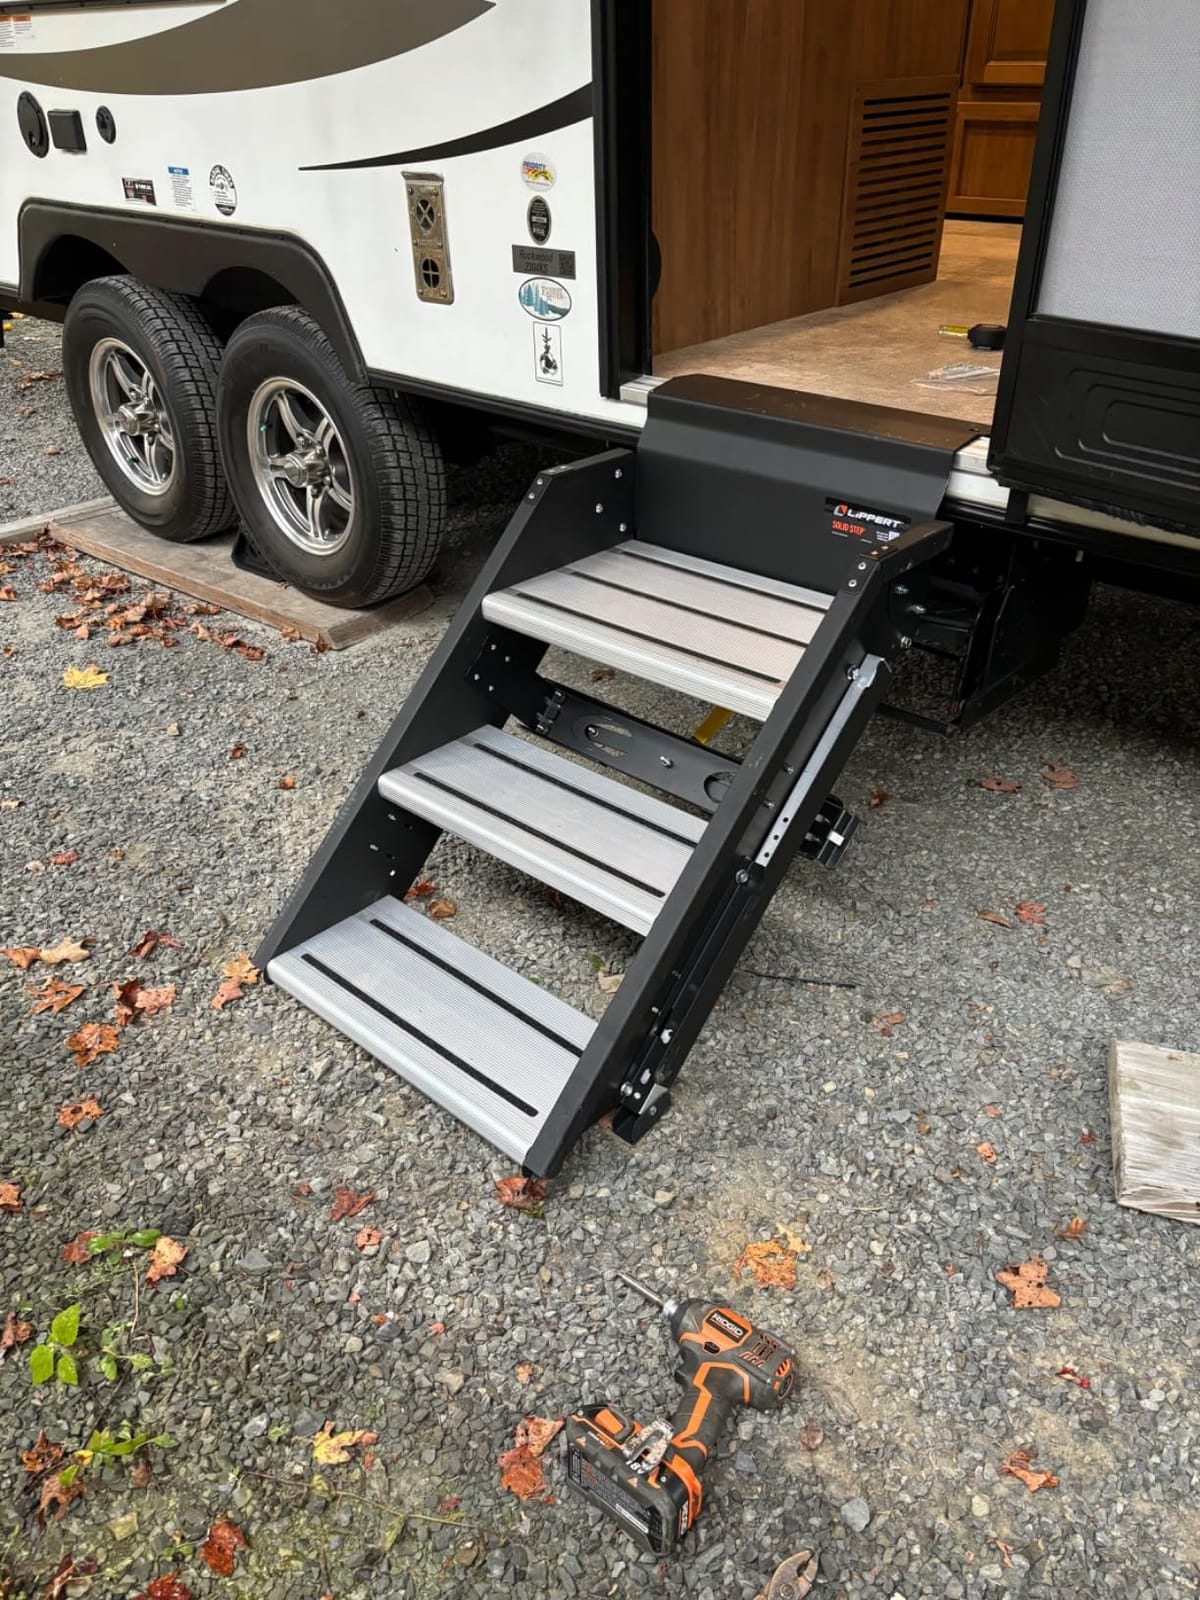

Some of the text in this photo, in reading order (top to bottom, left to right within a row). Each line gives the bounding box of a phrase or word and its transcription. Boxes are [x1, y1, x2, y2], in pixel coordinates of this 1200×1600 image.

[832, 520, 849, 532] SOLID
[849, 524, 864, 536] STEP
[847, 508, 904, 528] LIPPERT
[711, 1313, 744, 1336] RIDGID
